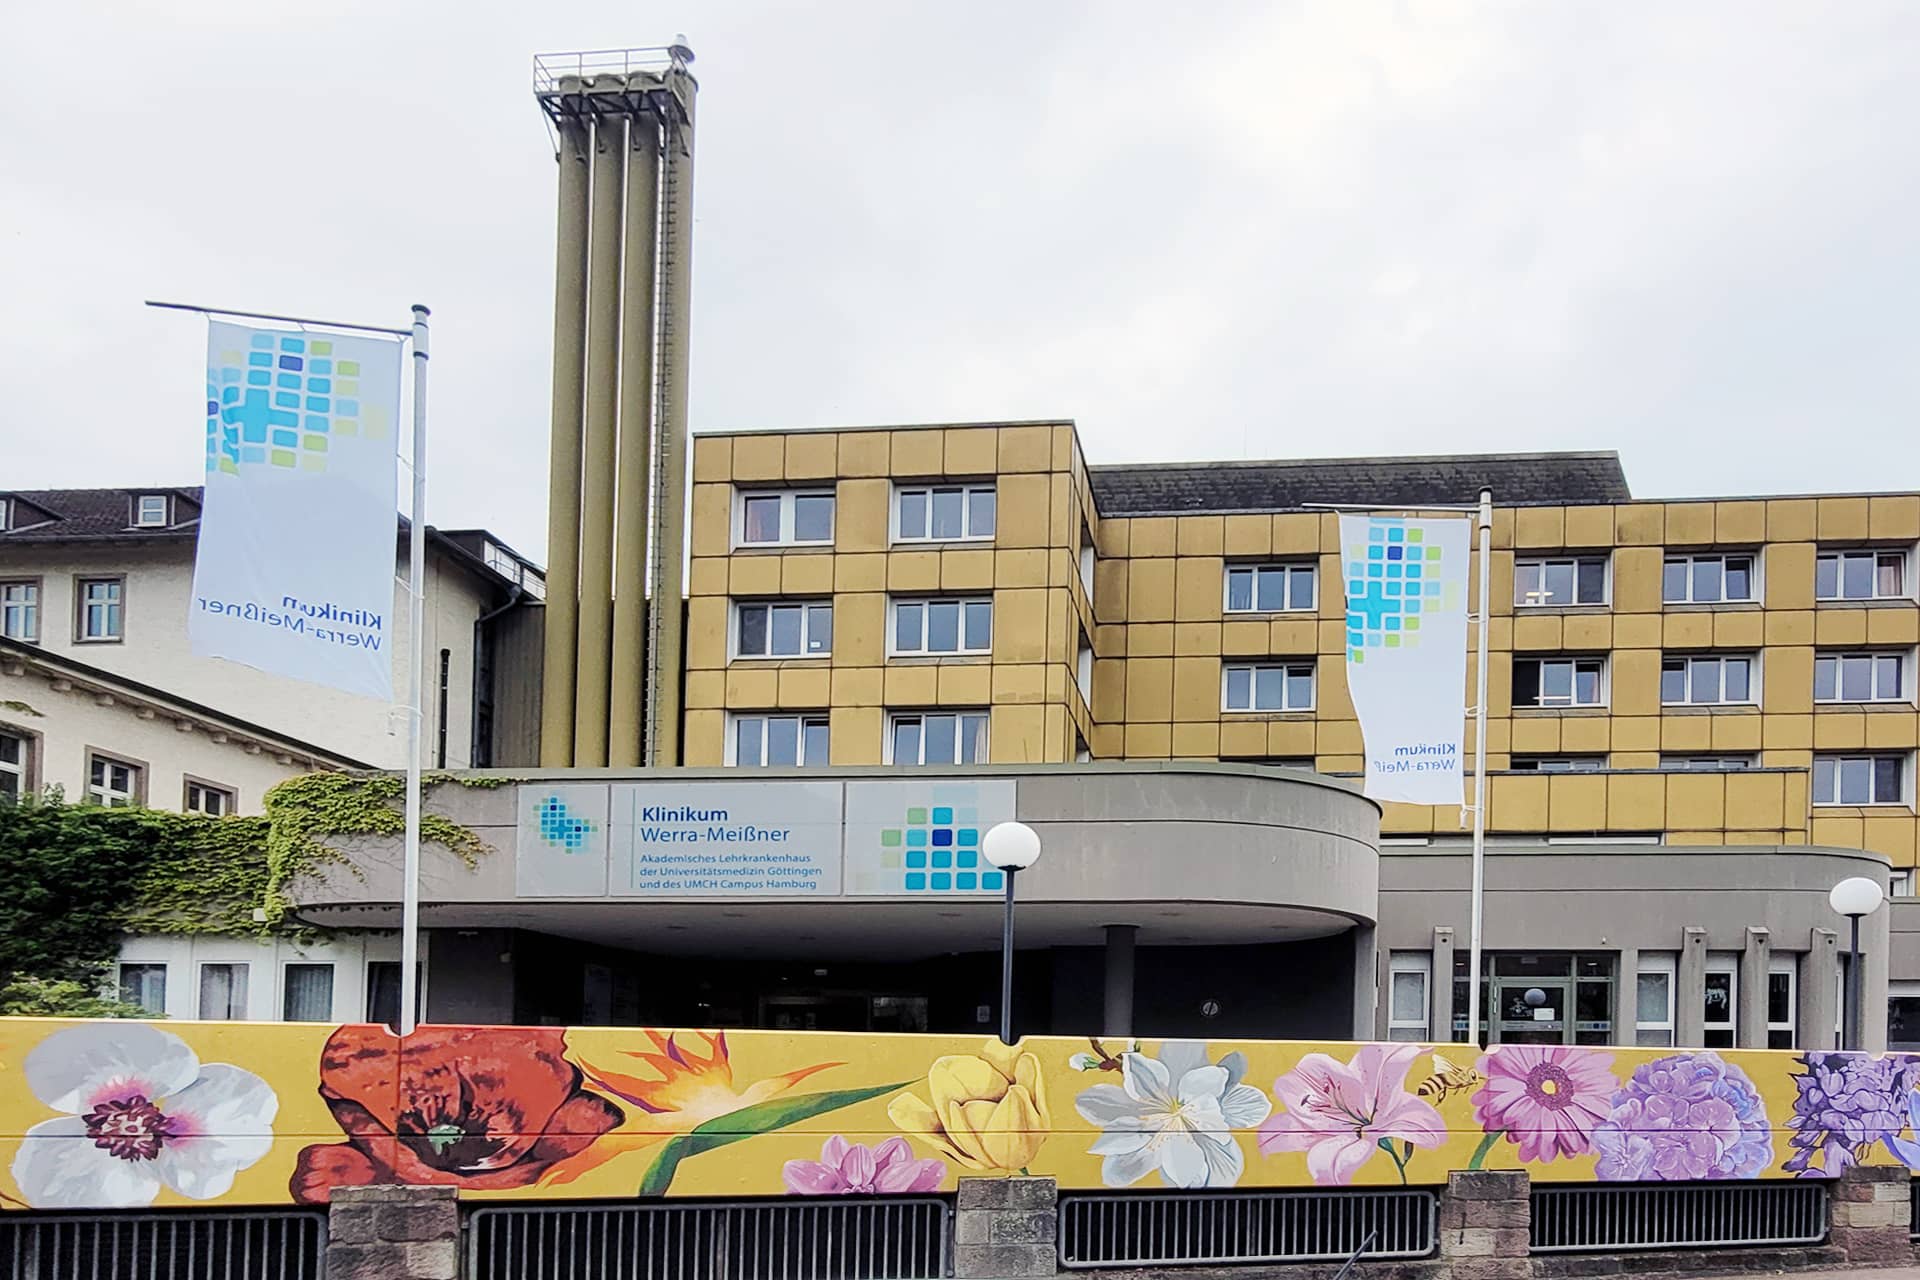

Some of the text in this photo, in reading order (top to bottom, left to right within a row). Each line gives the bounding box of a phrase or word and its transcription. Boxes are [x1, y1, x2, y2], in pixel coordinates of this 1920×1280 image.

[642, 806, 728, 822] Klinikum
[640, 825, 790, 842] Werra-Meißner
[640, 853, 811, 863] Akademisches Lehrkrankenhaus
[640, 866, 822, 878] der Universitätsmedizin Göttingen
[640, 879, 817, 890] und des UMCH Campus Hamburg
